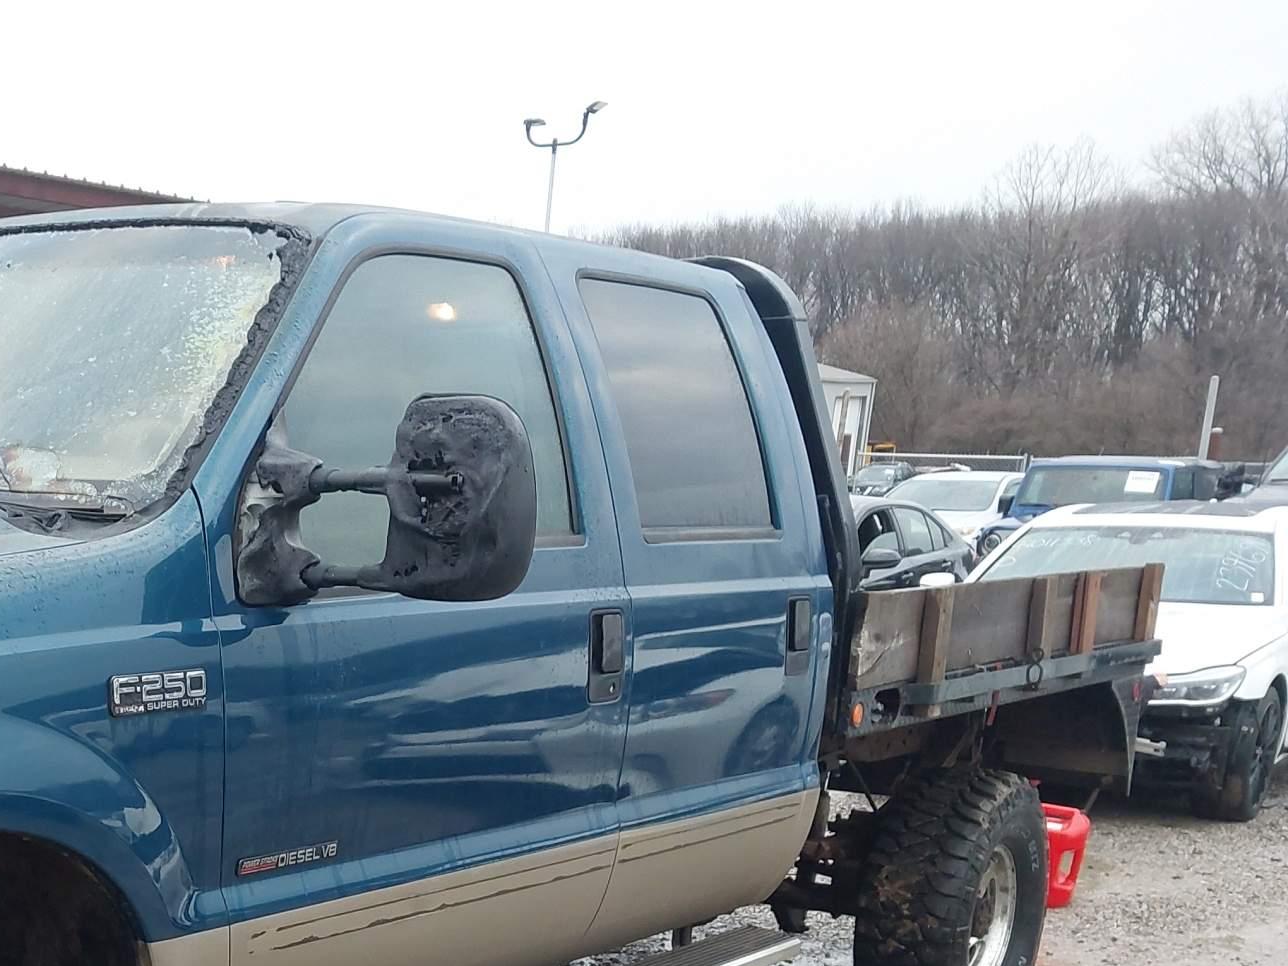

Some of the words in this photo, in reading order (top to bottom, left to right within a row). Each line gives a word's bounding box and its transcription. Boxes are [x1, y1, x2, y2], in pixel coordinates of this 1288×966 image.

[147, 700, 179, 711] SUPER
[182, 697, 207, 707] DUTY
[278, 847, 320, 867] DIESEL
[321, 843, 337, 859] V8
